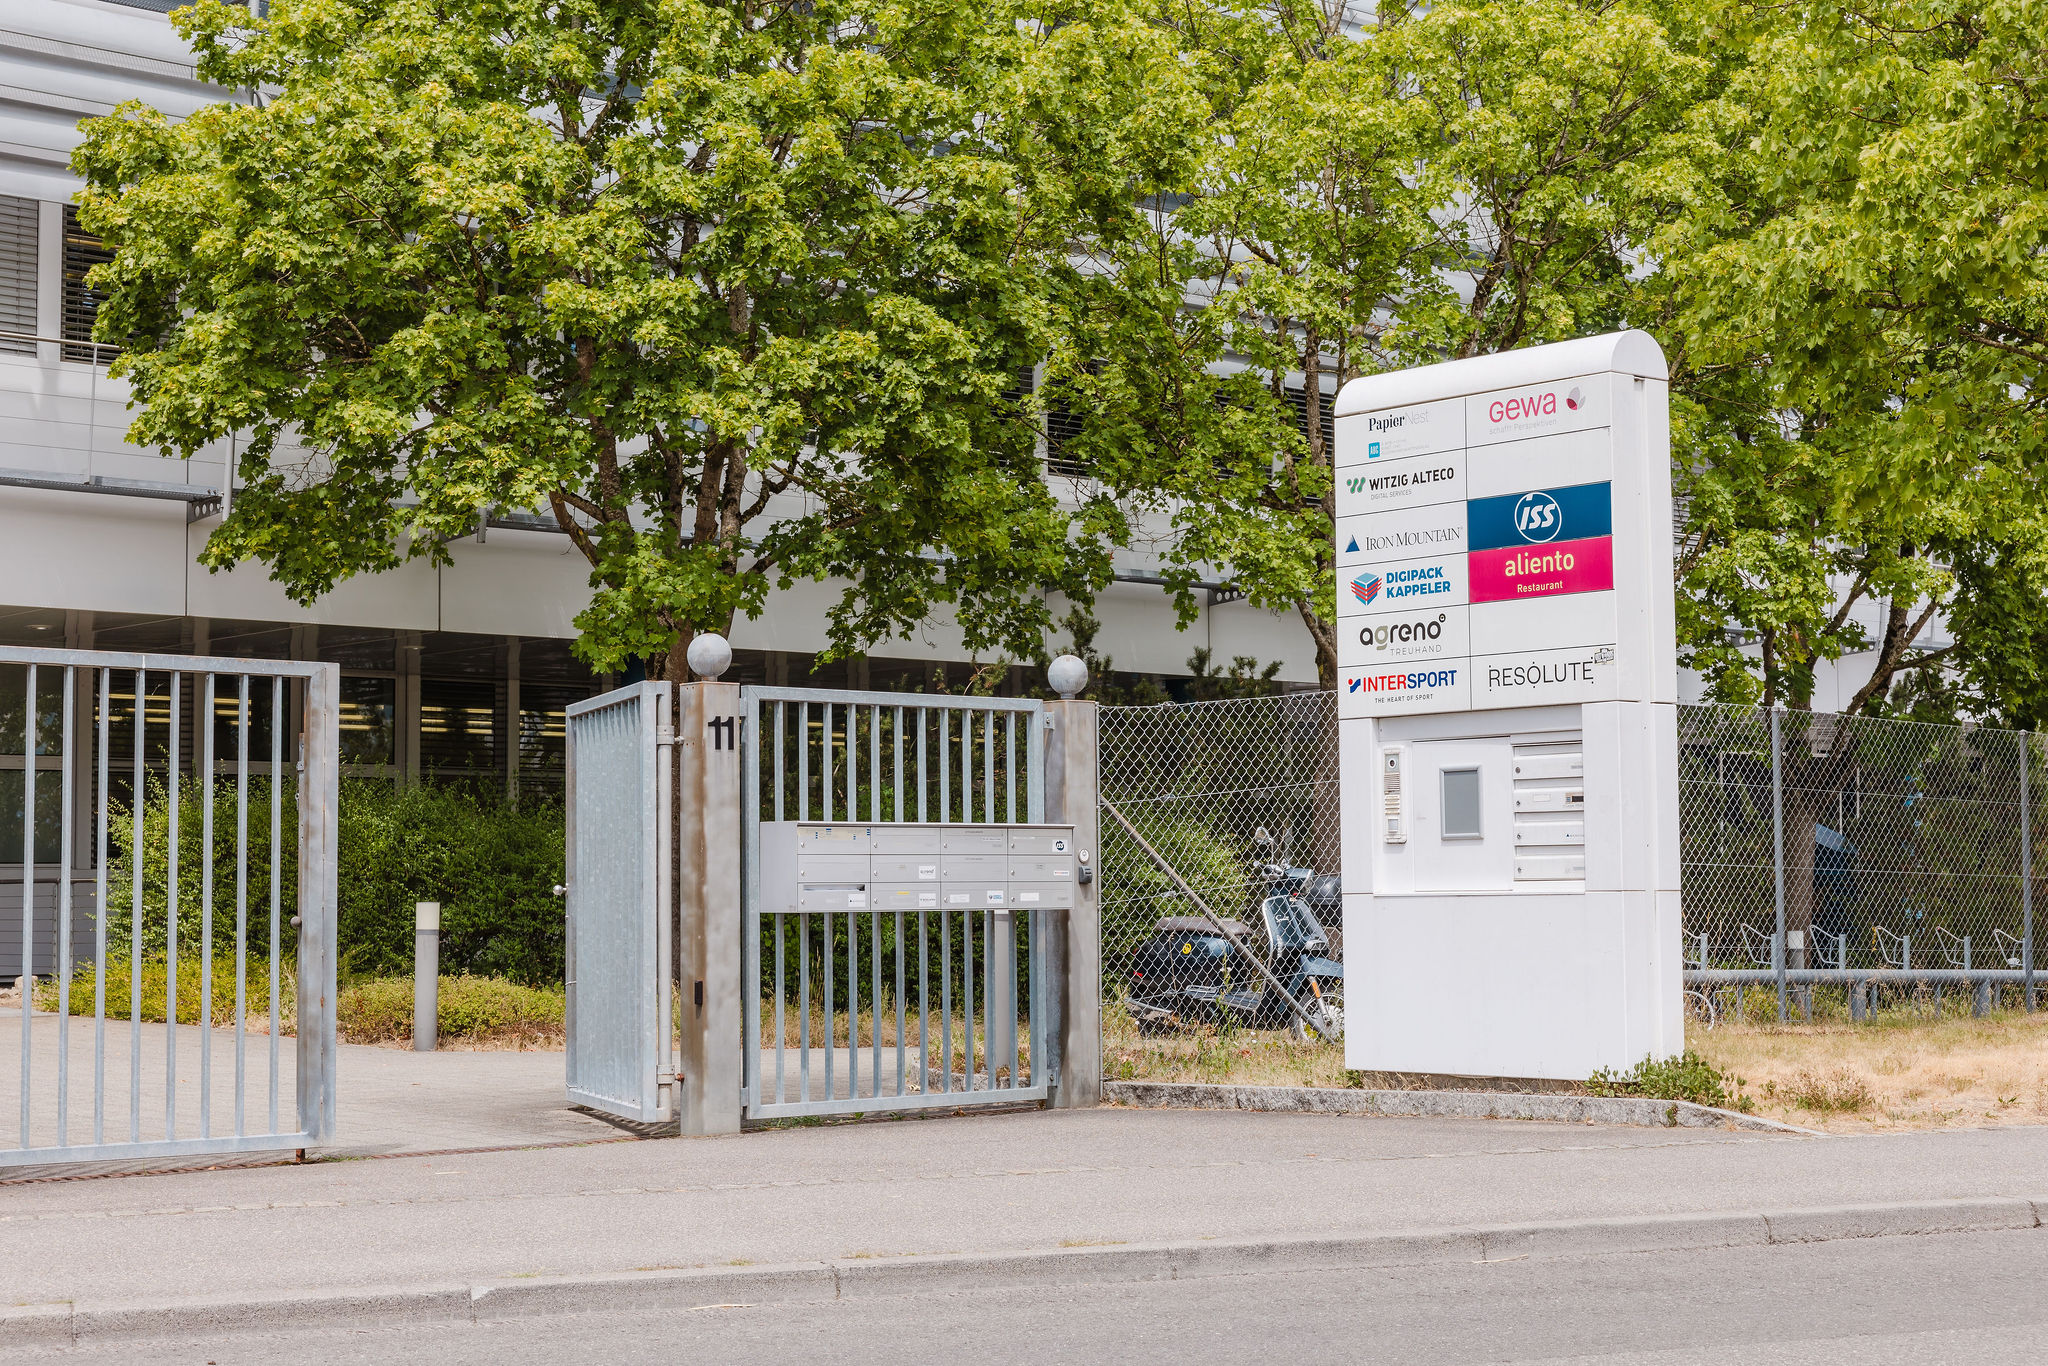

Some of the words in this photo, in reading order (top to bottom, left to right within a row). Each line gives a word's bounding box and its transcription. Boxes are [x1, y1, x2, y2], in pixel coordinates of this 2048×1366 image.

[1369, 474, 1408, 491] WITZIG
[1412, 467, 1454, 485] ALTECO
[1371, 490, 1388, 500] DIGITAL
[1389, 488, 1412, 498] SERVICES
[1365, 535, 1394, 551] IRON
[1505, 550, 1575, 577] aliento
[1386, 566, 1444, 584] DIGIPACK
[1386, 580, 1451, 599] KAPPELER
[1517, 580, 1563, 593] Restaurant
[1360, 620, 1441, 651] agreno
[1390, 644, 1442, 656] TREUHAND
[1363, 669, 1457, 693] INTERSPORT
[1489, 659, 1594, 689] RESOLUTE
[708, 715, 734, 750] 11
